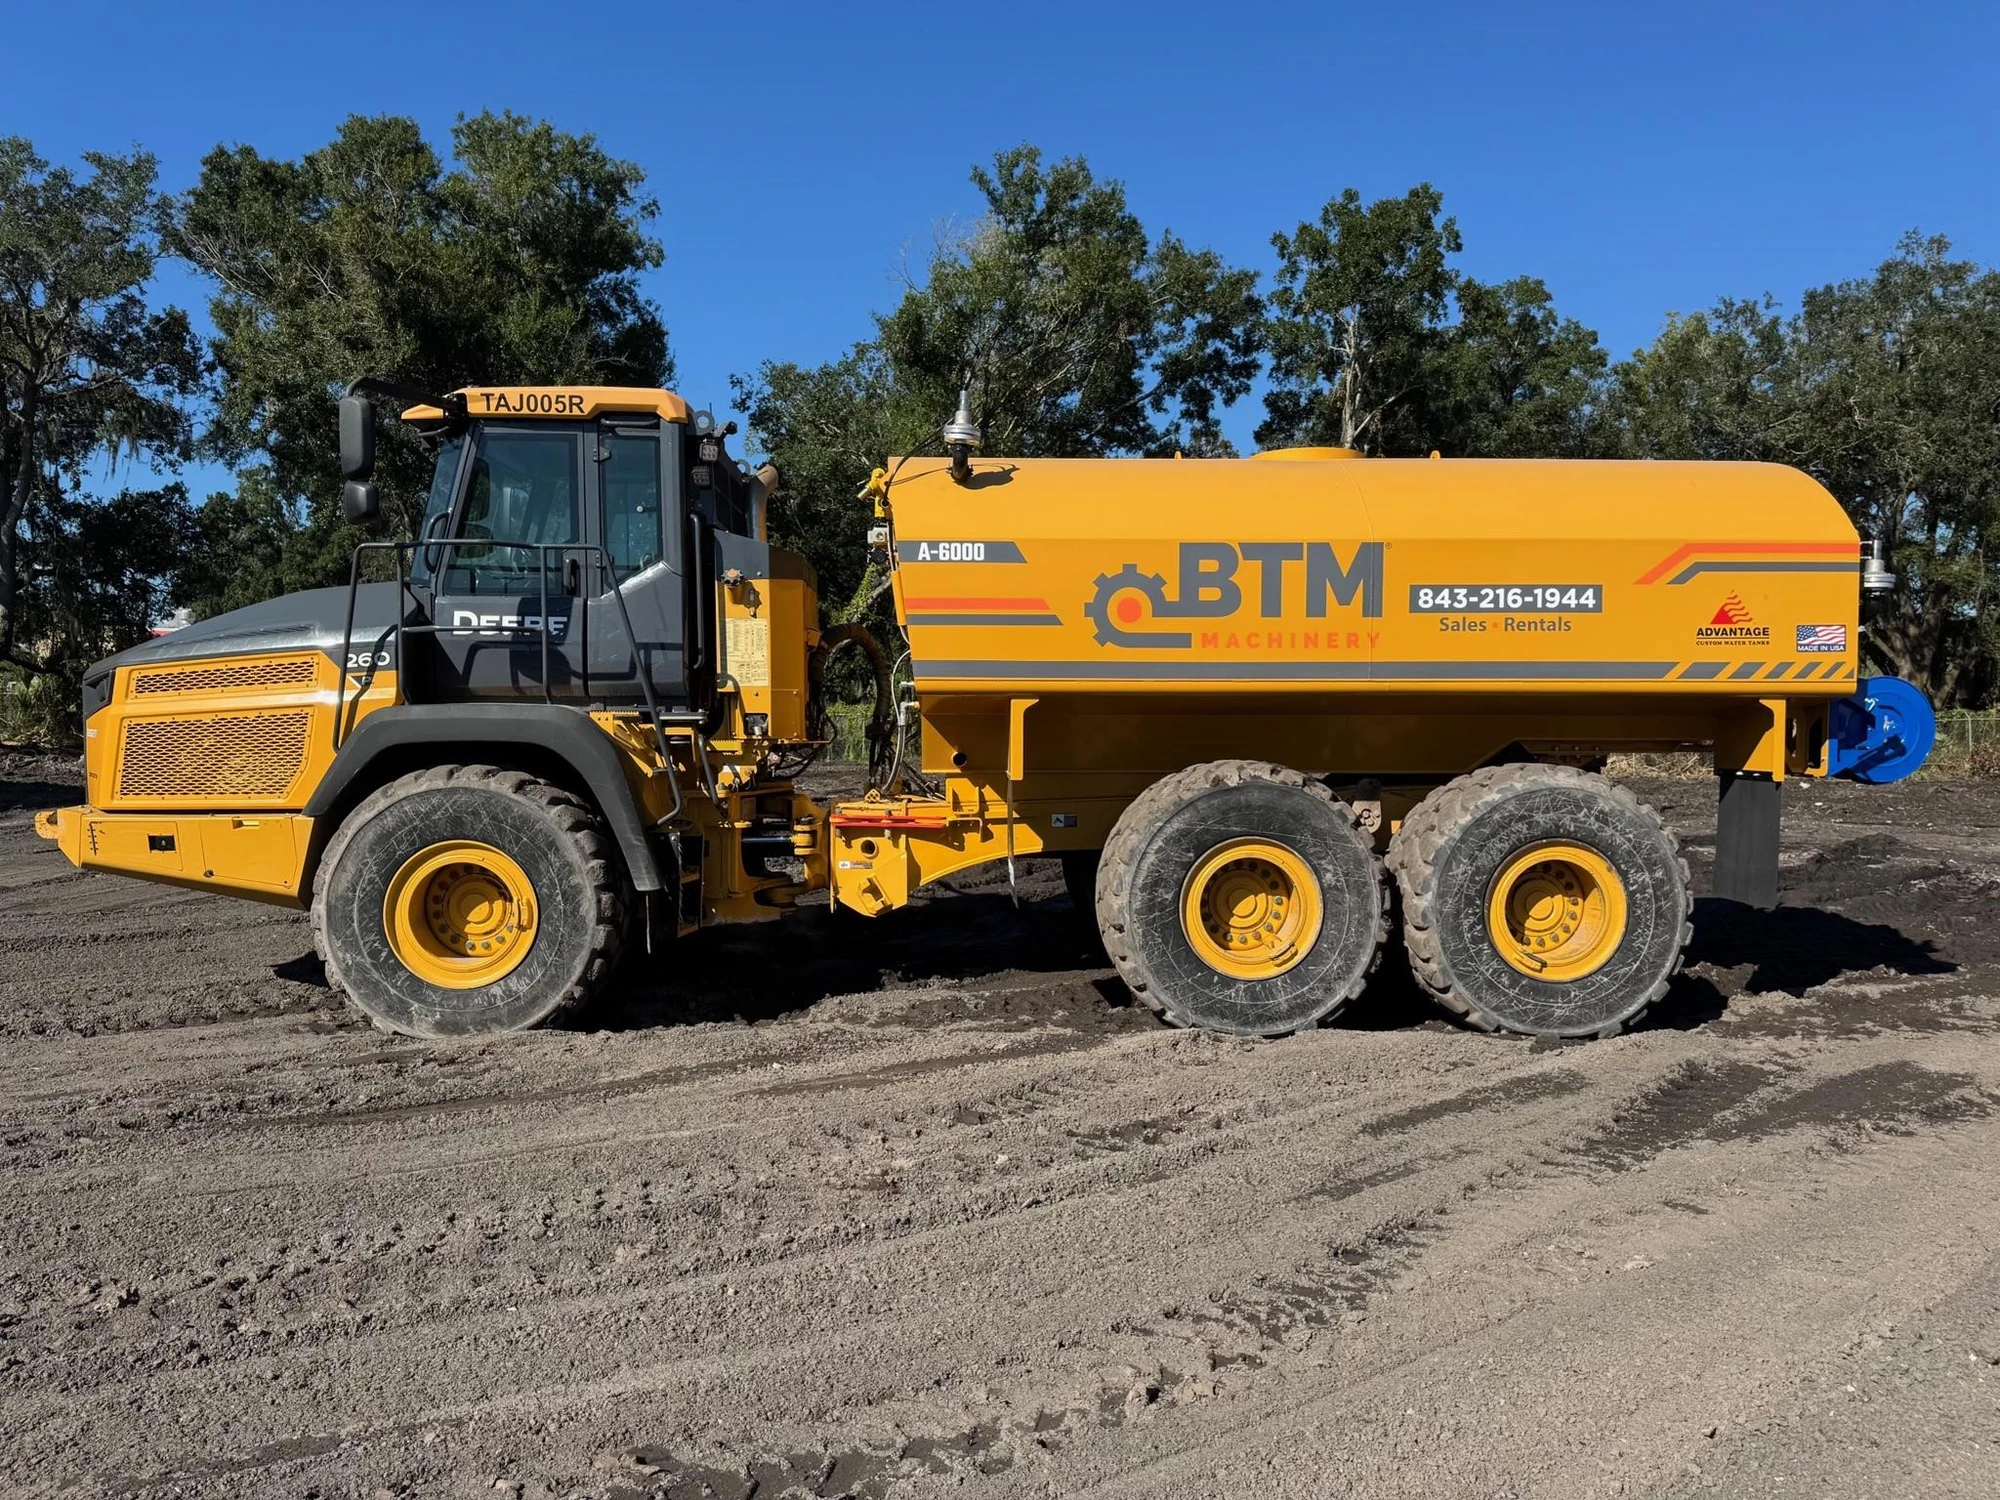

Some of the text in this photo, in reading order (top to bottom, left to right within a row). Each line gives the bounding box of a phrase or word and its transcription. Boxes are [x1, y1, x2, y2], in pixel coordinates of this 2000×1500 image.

[480, 392, 586, 414] TAJ005R
[917, 542, 985, 561] A-6000
[1178, 541, 1385, 618] BTM
[1418, 588, 1596, 609] 843-216-1944
[1439, 617, 1572, 632] Sales Rentals
[1696, 627, 1770, 637] ADVANTAGE
[1201, 632, 1382, 649] MACHINERY
[346, 651, 391, 668] 260
